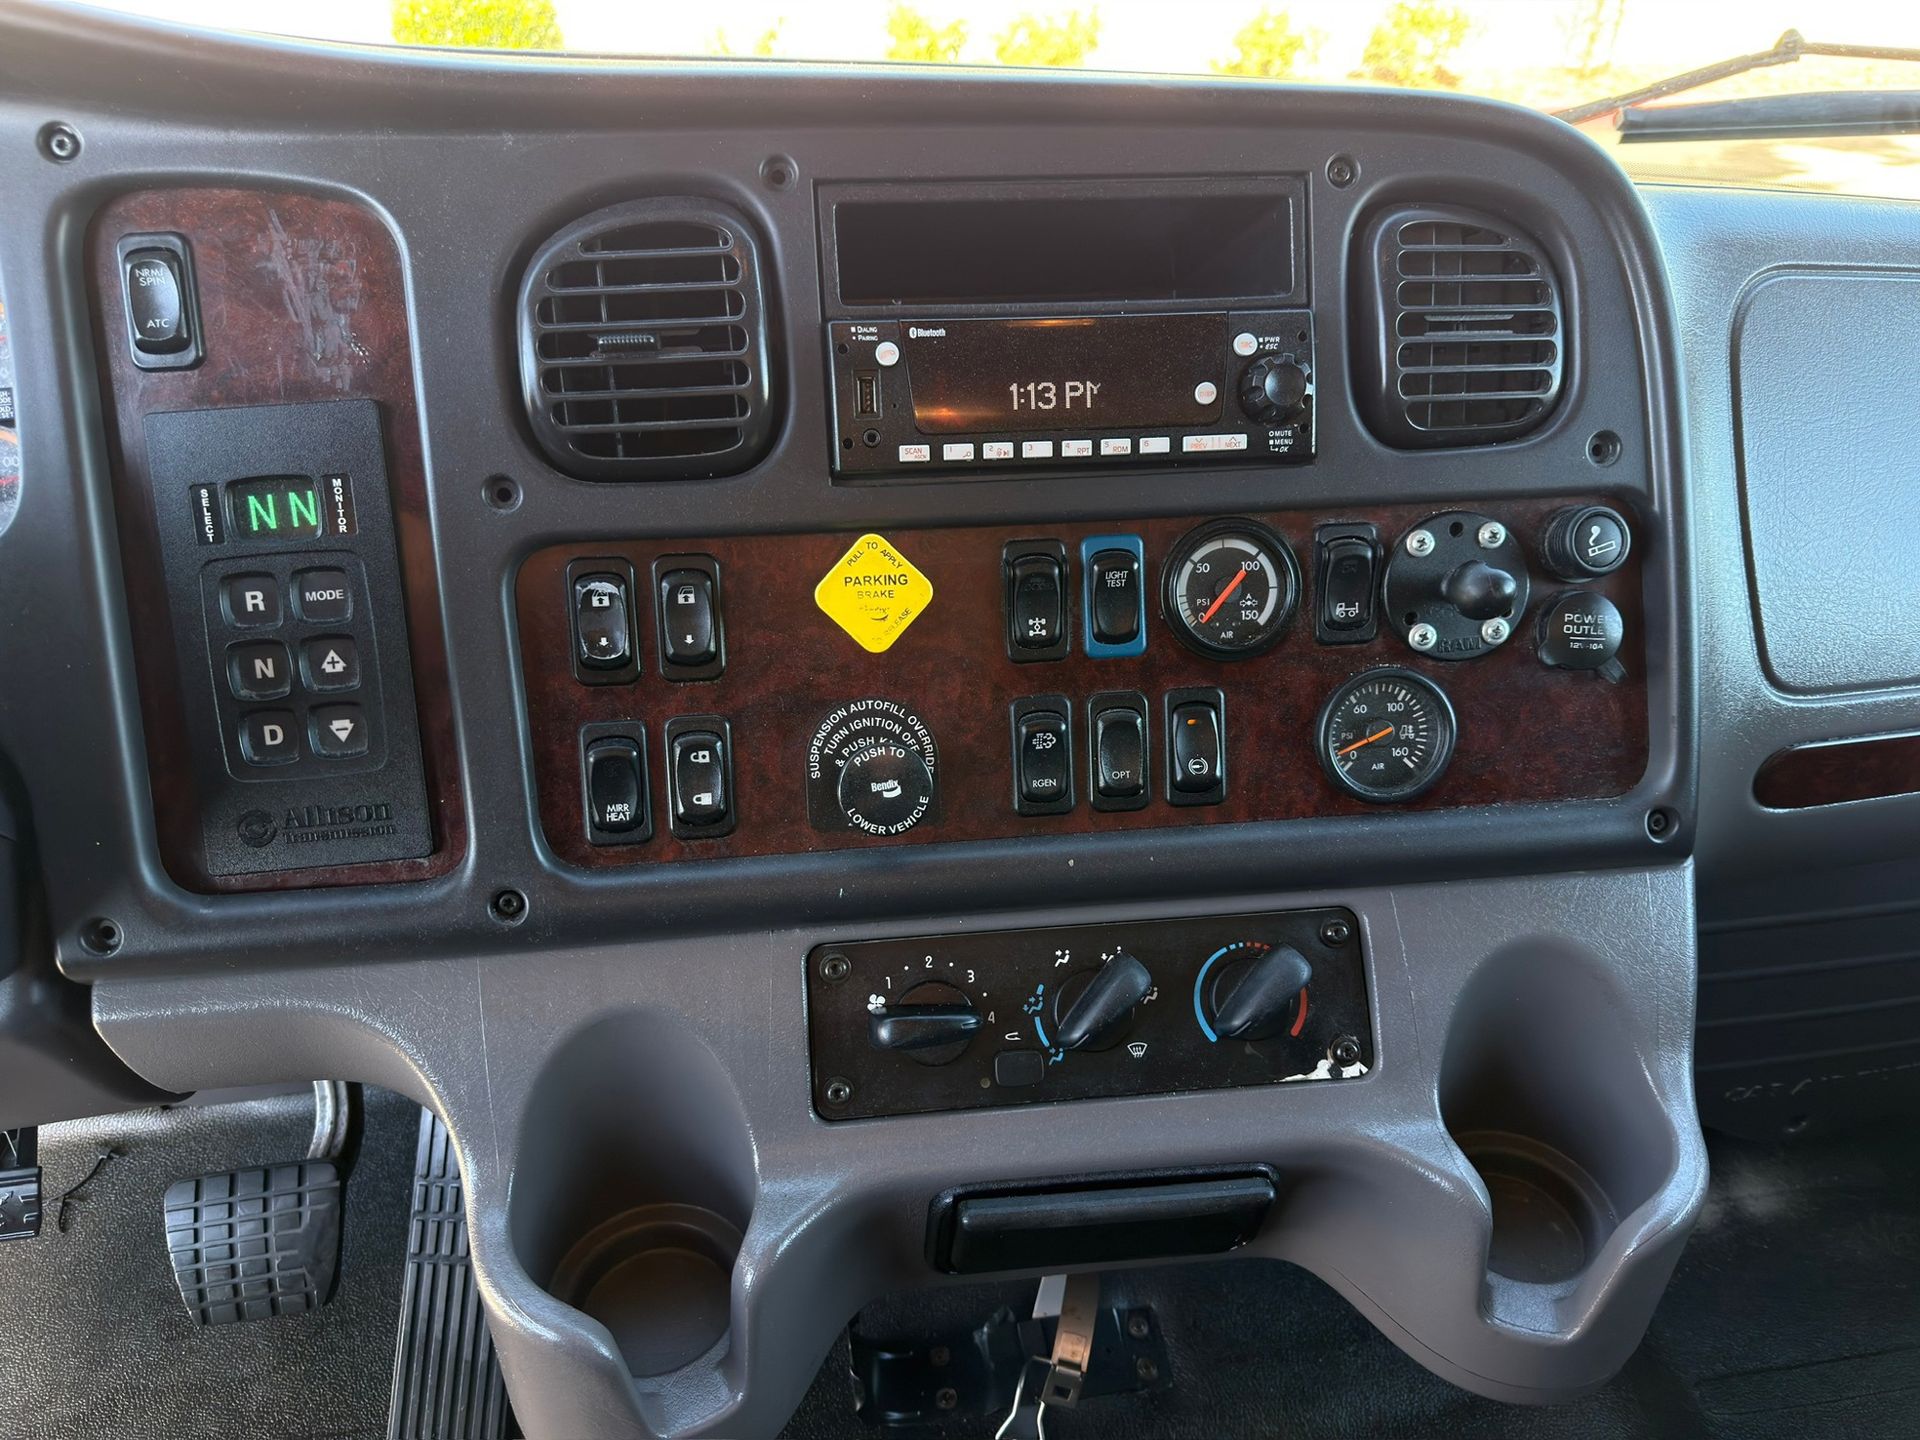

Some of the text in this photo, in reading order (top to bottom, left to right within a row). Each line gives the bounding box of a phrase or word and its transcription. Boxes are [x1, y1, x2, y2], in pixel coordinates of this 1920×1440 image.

[139, 277, 166, 287] SPIN
[147, 318, 170, 329] ATC
[917, 327, 946, 338] Bluetooth
[1009, 382, 1057, 411] 1:13
[331, 478, 348, 533] MONITOR
[200, 489, 215, 542] SELECT
[847, 541, 903, 569] PULL TO APPLY
[1195, 563, 1210, 573] 50
[1241, 561, 1260, 571] 100
[844, 574, 909, 587] PARKING
[1105, 570, 1129, 580] LIGHT
[1107, 579, 1126, 588] TEST
[245, 590, 266, 612] R
[305, 589, 344, 602] MODE
[1196, 598, 1210, 606] PSI
[1241, 610, 1259, 620] 150
[1564, 613, 1605, 624] POWE
[1220, 630, 1234, 639] AIR
[1563, 624, 1605, 635] OUTLE
[254, 658, 275, 679] N
[1353, 704, 1367, 714] 60
[1387, 702, 1404, 712] 100
[263, 724, 284, 745] D
[809, 707, 848, 779] SUSPENSION
[849, 700, 905, 718] AUTOFILL
[823, 717, 920, 756] TURN IGNITION OFF
[835, 758, 845, 768] &
[841, 736, 875, 757] PUSH
[854, 746, 906, 767] PUSH TO
[1349, 750, 1357, 760] 0
[1391, 747, 1408, 757] 160
[1111, 770, 1131, 780] OPT
[870, 779, 899, 792] Bendix
[1032, 778, 1057, 788] RGEN
[606, 803, 630, 813] MIRR
[283, 804, 393, 829] Allison
[606, 811, 631, 822] HEAT
[847, 795, 929, 835] LOWER VEHICLE
[925, 955, 933, 968] 2
[967, 969, 975, 983] 3
[885, 976, 891, 989] 1
[988, 1011, 996, 1024] 4
